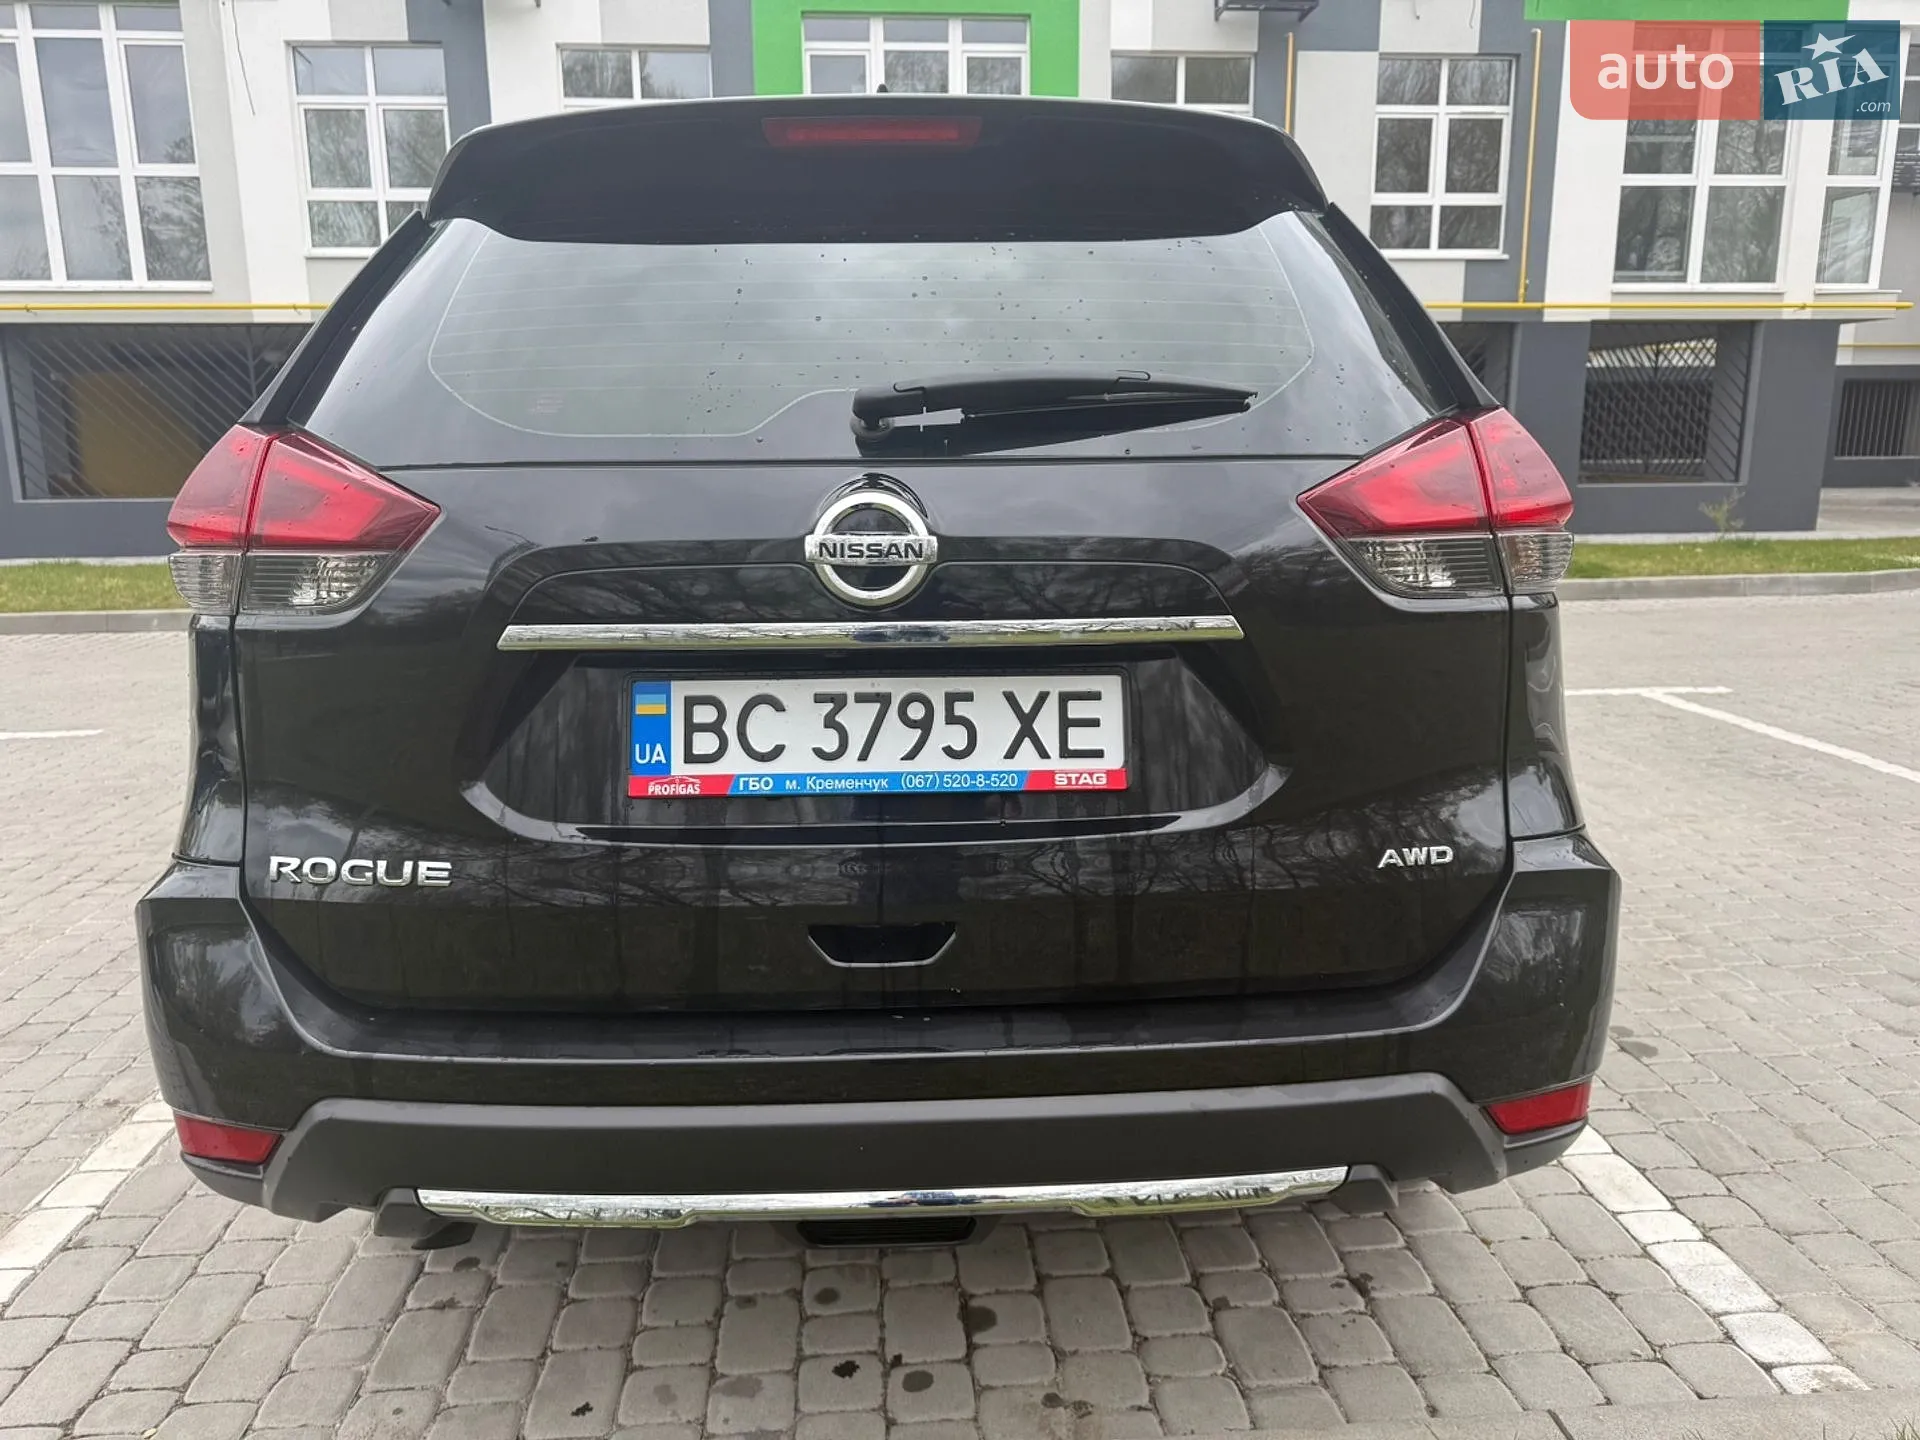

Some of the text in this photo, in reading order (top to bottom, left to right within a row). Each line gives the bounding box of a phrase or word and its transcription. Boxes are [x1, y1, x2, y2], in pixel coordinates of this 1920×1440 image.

[818, 542, 923, 559] NISSAN
[683, 690, 1105, 764] BC 3795 XE
[635, 743, 667, 764] UA
[738, 773, 1018, 792] ГБО м. Кременчук (067) 520-8-520
[1054, 773, 1108, 786] STAG
[1377, 845, 1454, 869] AWD
[269, 855, 453, 887] ROGUE
